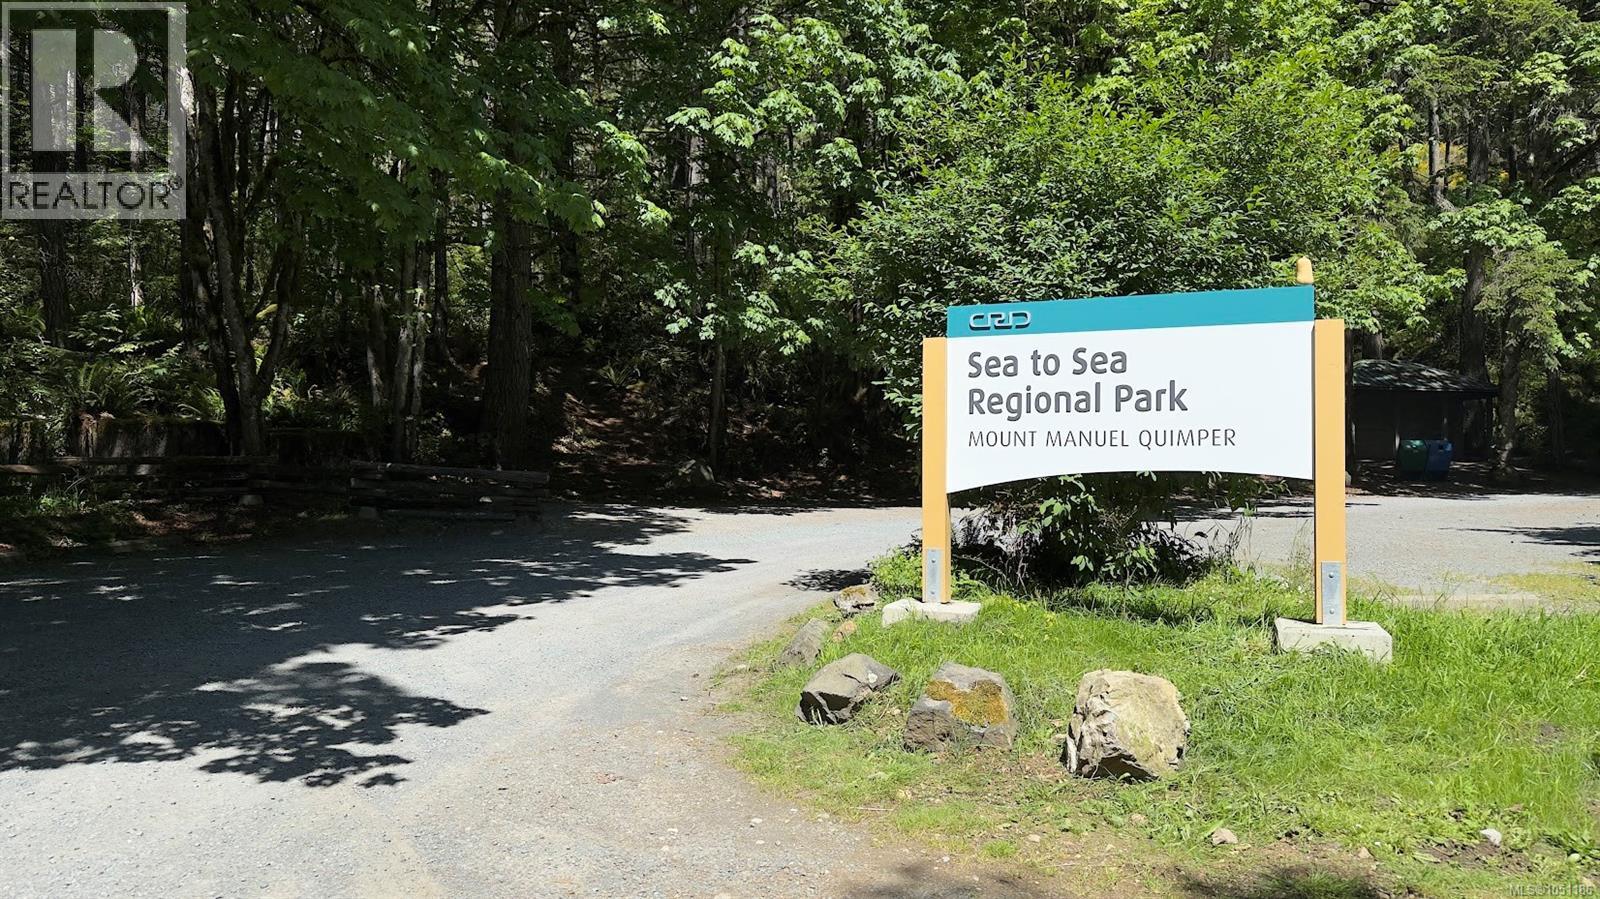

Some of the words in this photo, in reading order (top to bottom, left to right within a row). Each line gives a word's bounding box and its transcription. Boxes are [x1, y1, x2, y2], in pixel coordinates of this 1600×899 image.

[969, 310, 1032, 331] CRD
[968, 351, 1019, 378] Sea
[1030, 349, 1061, 376] to
[1072, 347, 1128, 375] Sea
[968, 382, 1101, 422] Regional
[1115, 379, 1188, 412] Park
[968, 430, 1037, 448] MOUNT
[1045, 429, 1129, 448] MANUEL
[1138, 428, 1236, 450] QUIMPER
